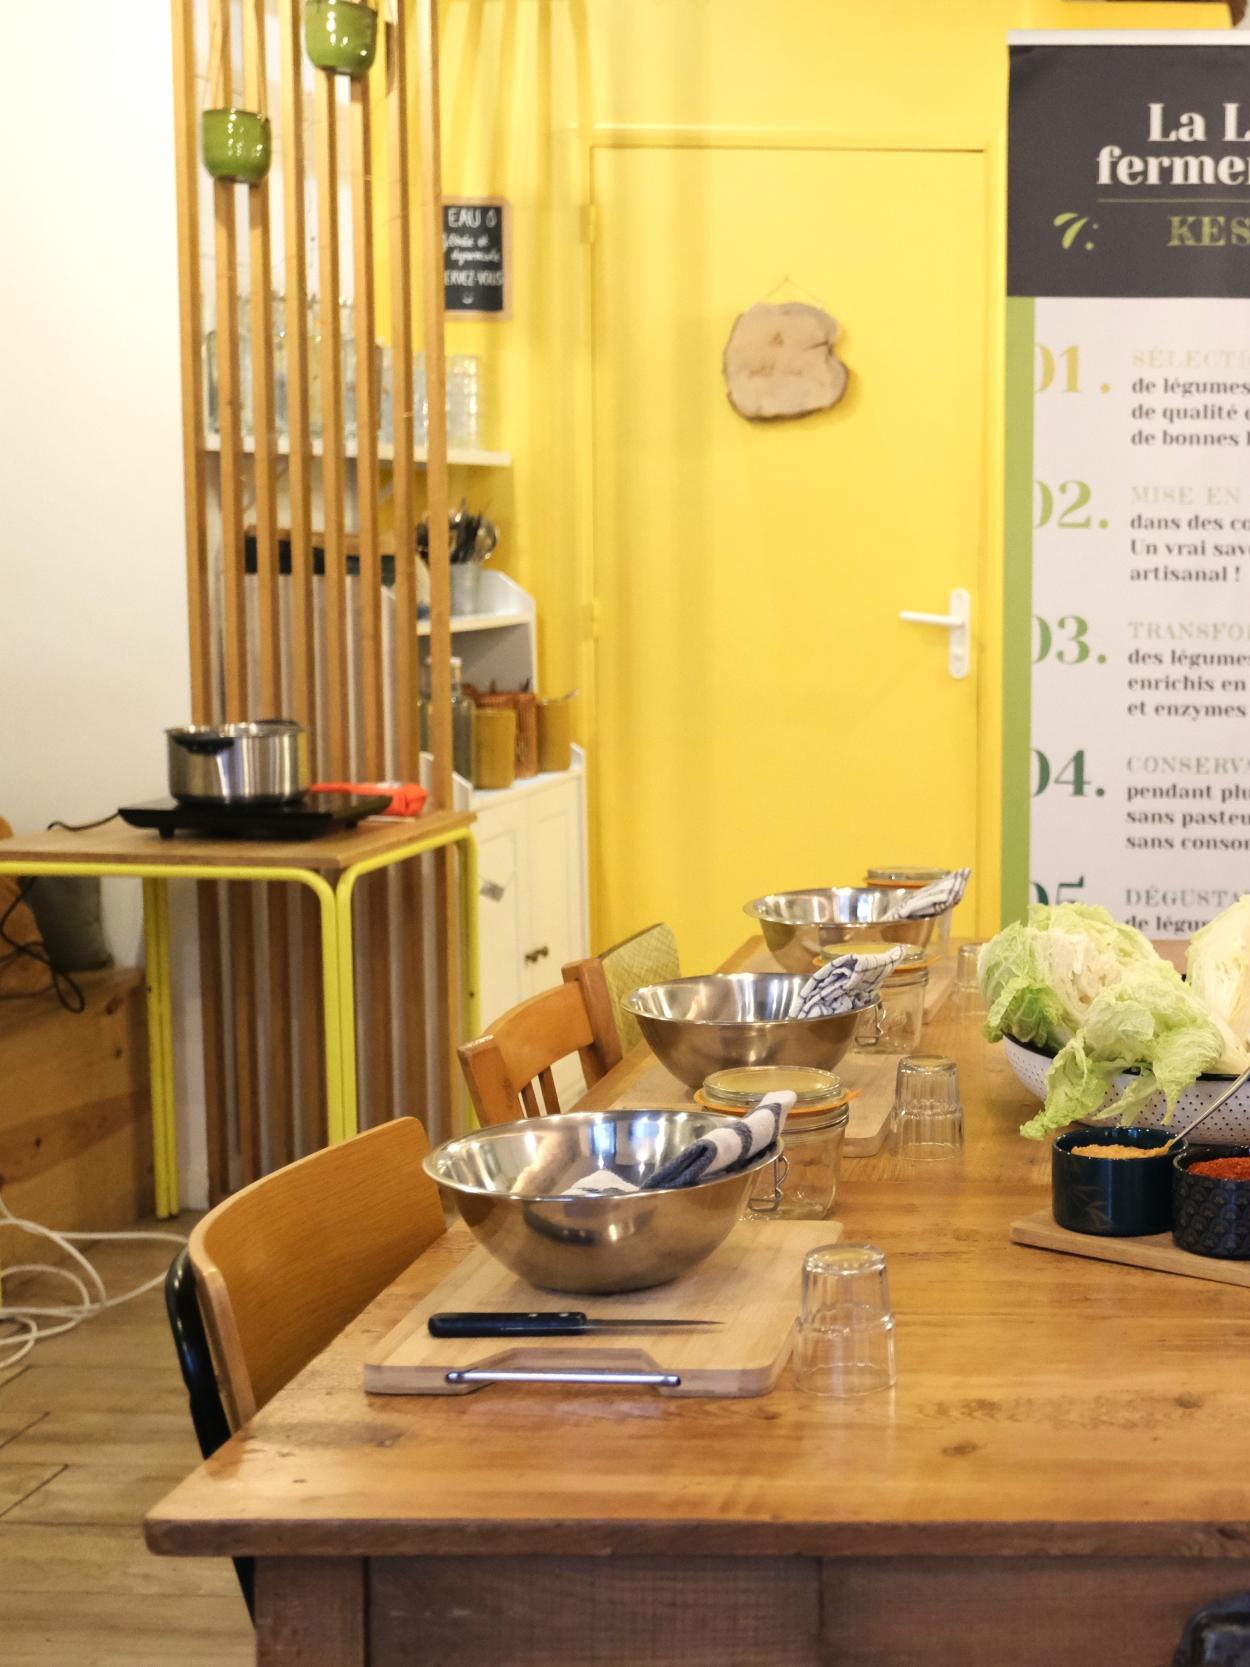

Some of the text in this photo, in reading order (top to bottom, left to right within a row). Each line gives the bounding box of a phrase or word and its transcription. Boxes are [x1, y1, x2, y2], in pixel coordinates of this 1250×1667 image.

[1148, 102, 1207, 143] La
[447, 207, 482, 228] EAU
[443, 269, 503, 287] ERVEZ-VOUS
[1131, 377, 1157, 395] de
[1131, 403, 1157, 421] de
[1162, 403, 1239, 425] qualité
[1130, 429, 1157, 447] de
[1162, 429, 1241, 447] bonnes
[1131, 485, 1194, 506] MISE
[1205, 485, 1241, 506] EN
[1130, 513, 1182, 532] dans
[1187, 514, 1225, 532] des
[1130, 538, 1159, 557] Un
[1164, 539, 1208, 558] vrai
[1129, 565, 1229, 584] artisanal
[1127, 648, 1165, 666] des
[1127, 675, 1216, 693] enrichis
[1221, 680, 1247, 693] en
[1127, 701, 1148, 718] et
[1154, 704, 1248, 722] enzymes
[1127, 783, 1213, 804] pendant
[1126, 811, 1176, 826] sans
[1126, 837, 1176, 852] sans
[1124, 916, 1150, 931] de
[1156, 916, 1209, 934] légu
